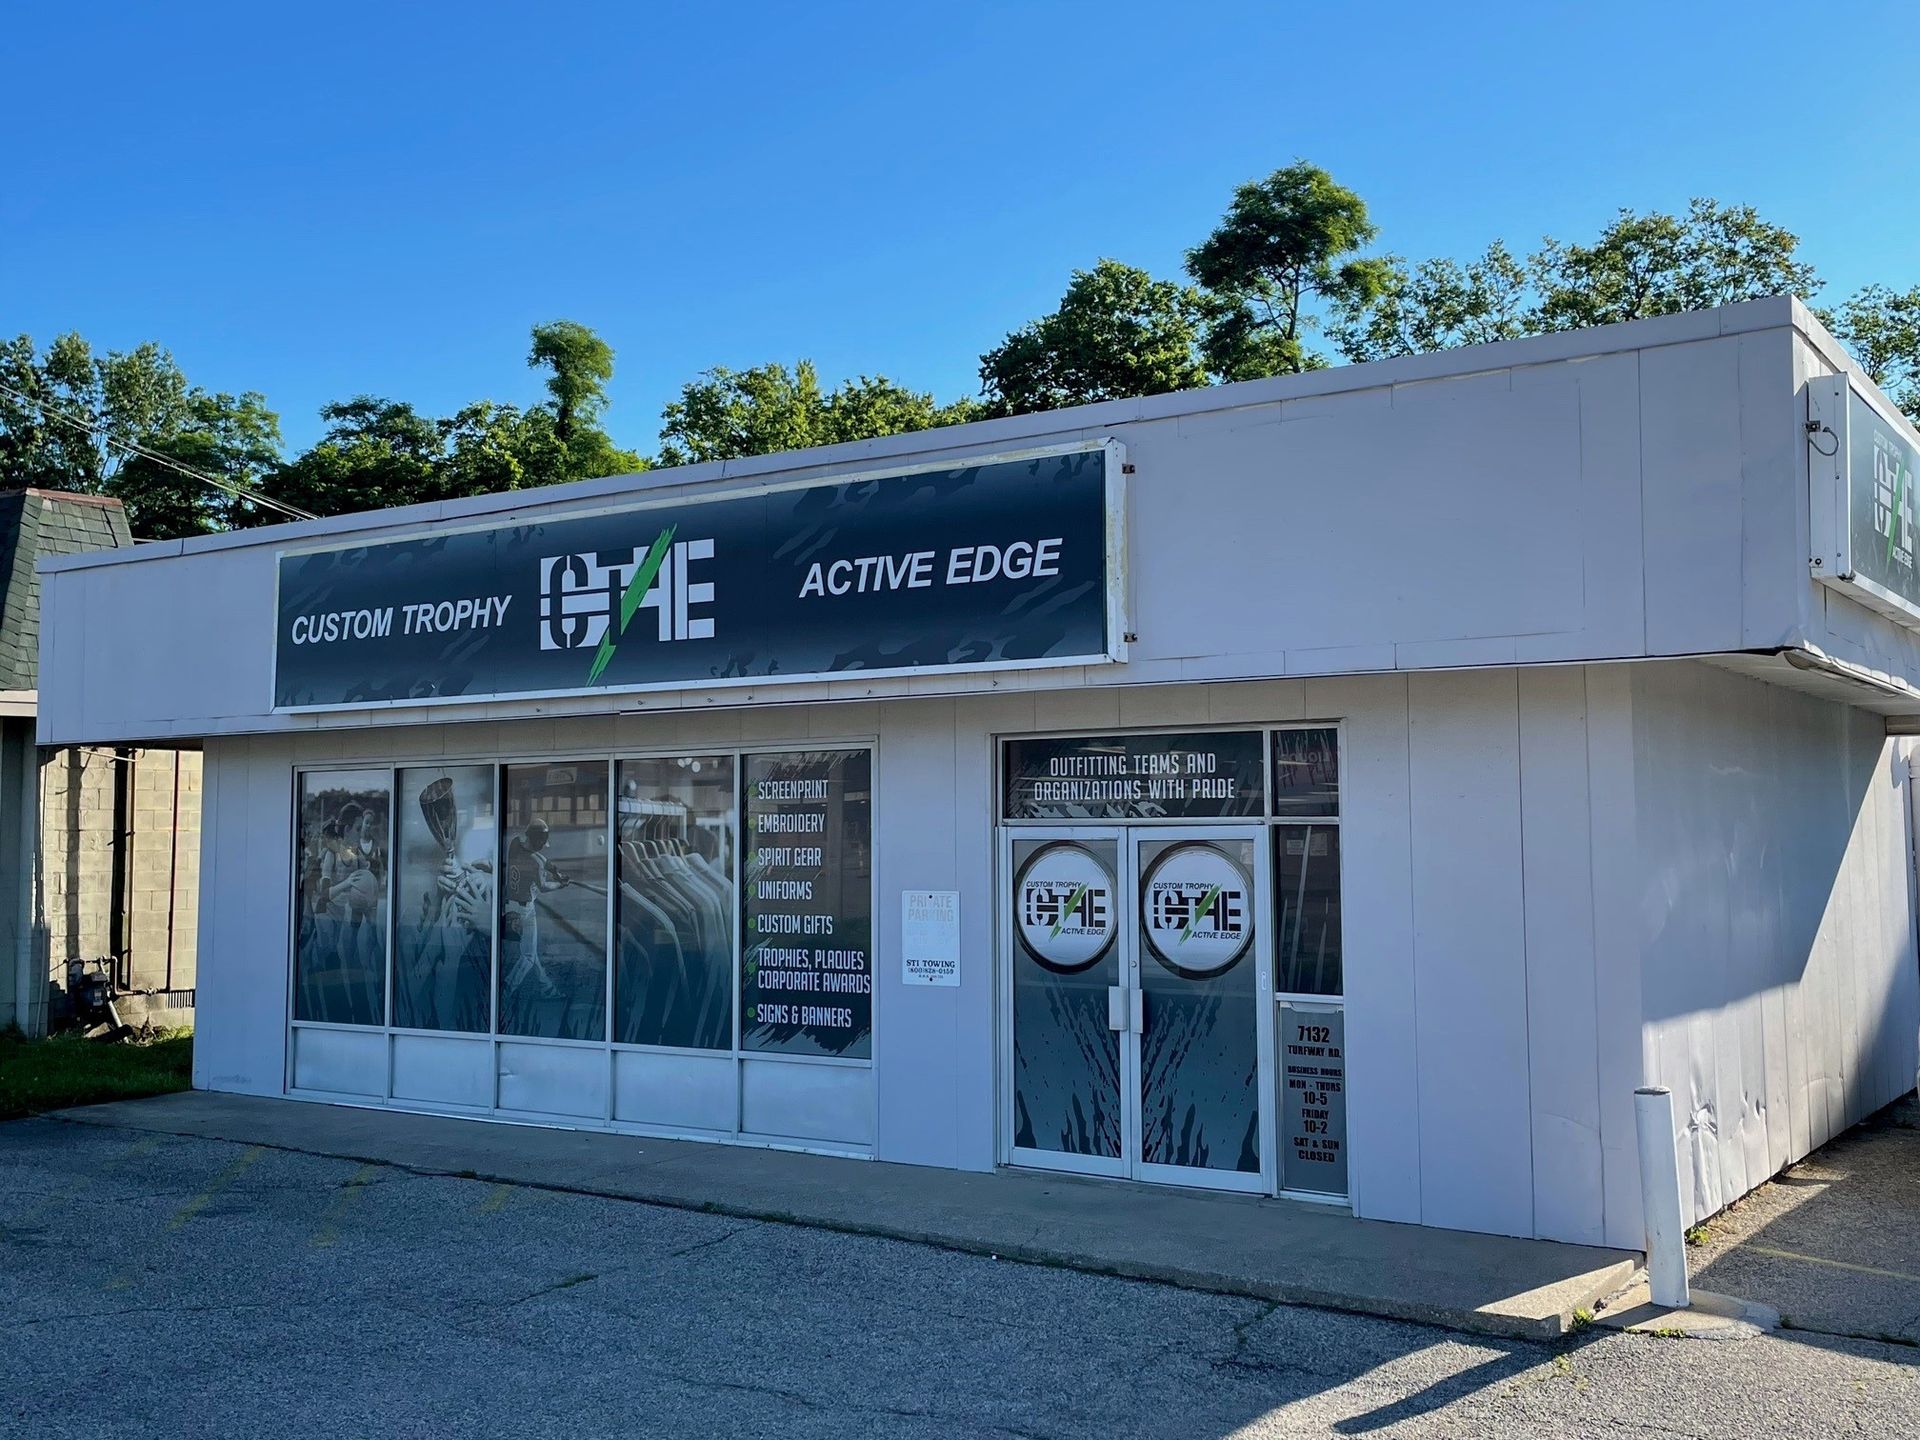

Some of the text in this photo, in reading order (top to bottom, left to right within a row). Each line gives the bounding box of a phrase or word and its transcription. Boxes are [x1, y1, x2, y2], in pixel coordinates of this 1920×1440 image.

[798, 537, 1063, 599] ACTIVE EDGE
[291, 594, 513, 645] CUSTOM TROPHY
[1050, 753, 1216, 776] OUTFITTING TEAMS AND
[758, 779, 829, 800] SCREENPRINT
[1034, 778, 1235, 801] ORGANIZATIONS WITH PRIDE
[758, 813, 825, 833] EMBROIDERY
[758, 847, 822, 866] SPIRIT GEAR
[758, 881, 812, 900] UNIFORMS
[1026, 880, 1082, 888] CUSTOM TROPHY
[1153, 882, 1214, 890] CUSTOM TROPHY
[910, 895, 952, 908] PRIATE
[757, 914, 833, 935] CUSTOM GIFTS
[1061, 928, 1106, 936] ACTIVE EDGE
[1192, 931, 1241, 940] ACTIVE EDGE
[758, 948, 865, 971] TROPHIES, PLAQUES
[906, 959, 955, 968] STI TOWING
[758, 970, 871, 994] CORPORATE AWARDS
[757, 1004, 852, 1028] SIGNS & BANNERS
[1298, 1025, 1330, 1043] 7132
[1288, 1045, 1325, 1057] TURFWAY
[1321, 1068, 1342, 1077] HOURS
[1289, 1079, 1307, 1089] MON
[1315, 1081, 1341, 1092] THURS
[1303, 1091, 1328, 1105] 10-5
[1302, 1108, 1329, 1120] FRIDAY
[1304, 1119, 1328, 1134] 10-2
[1294, 1137, 1309, 1147] SAT
[1322, 1140, 1340, 1150] SUN
[1298, 1150, 1335, 1162] CLOSED
